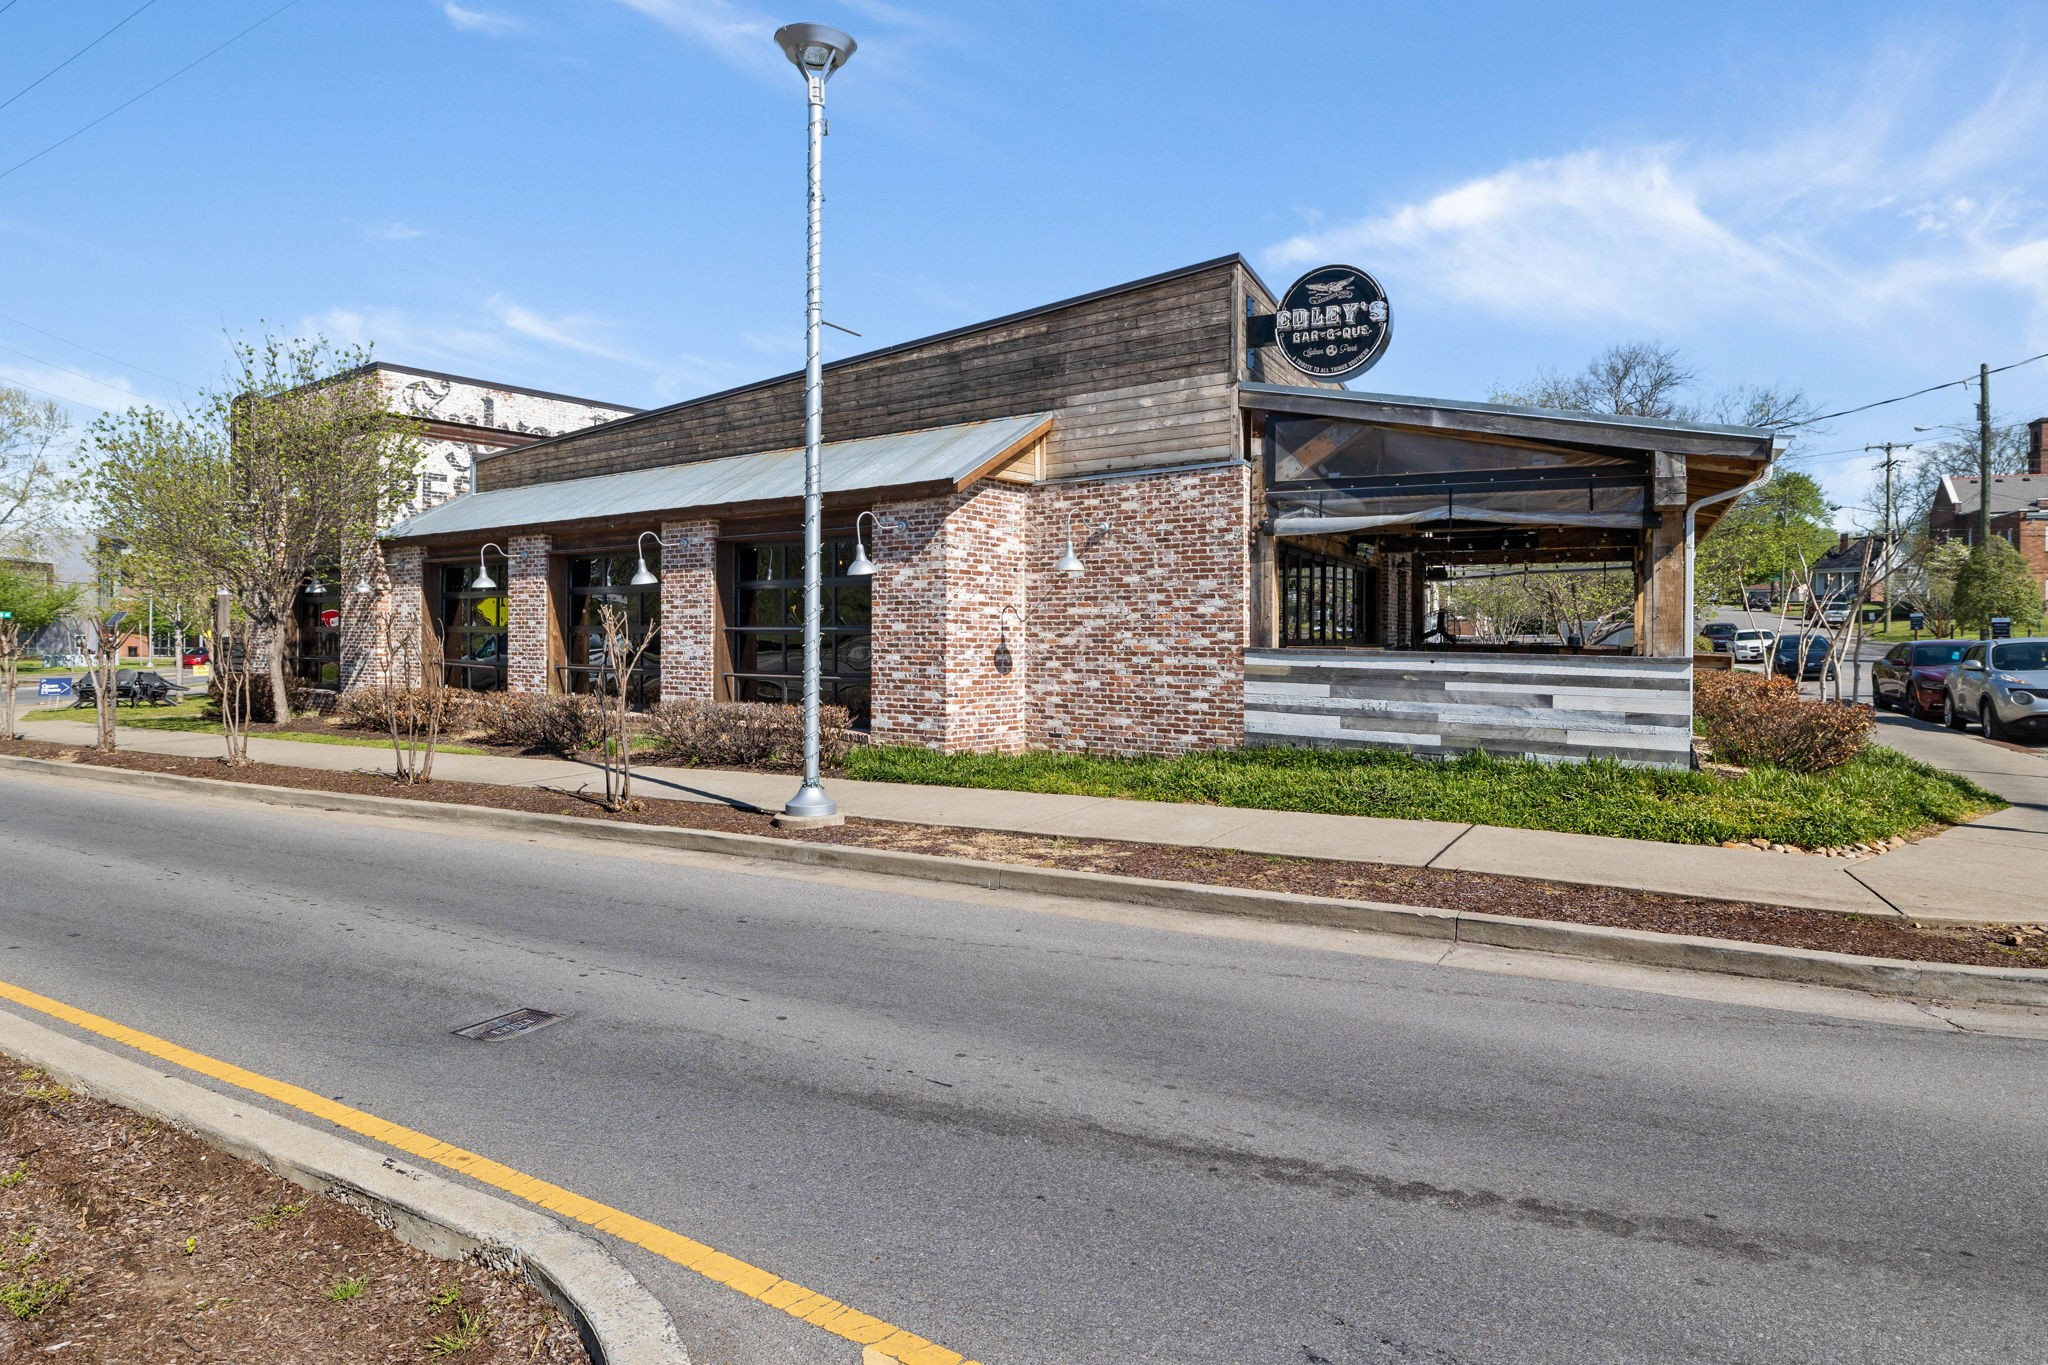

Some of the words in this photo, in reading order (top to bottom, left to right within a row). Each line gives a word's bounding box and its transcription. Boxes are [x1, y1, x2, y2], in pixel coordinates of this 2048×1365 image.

[1277, 301, 1388, 331] EDLEY'S
[1295, 358, 1312, 371] TRIBUTE
[1331, 363, 1348, 373] THINGS
[1348, 348, 1370, 367] SOUTHERN
